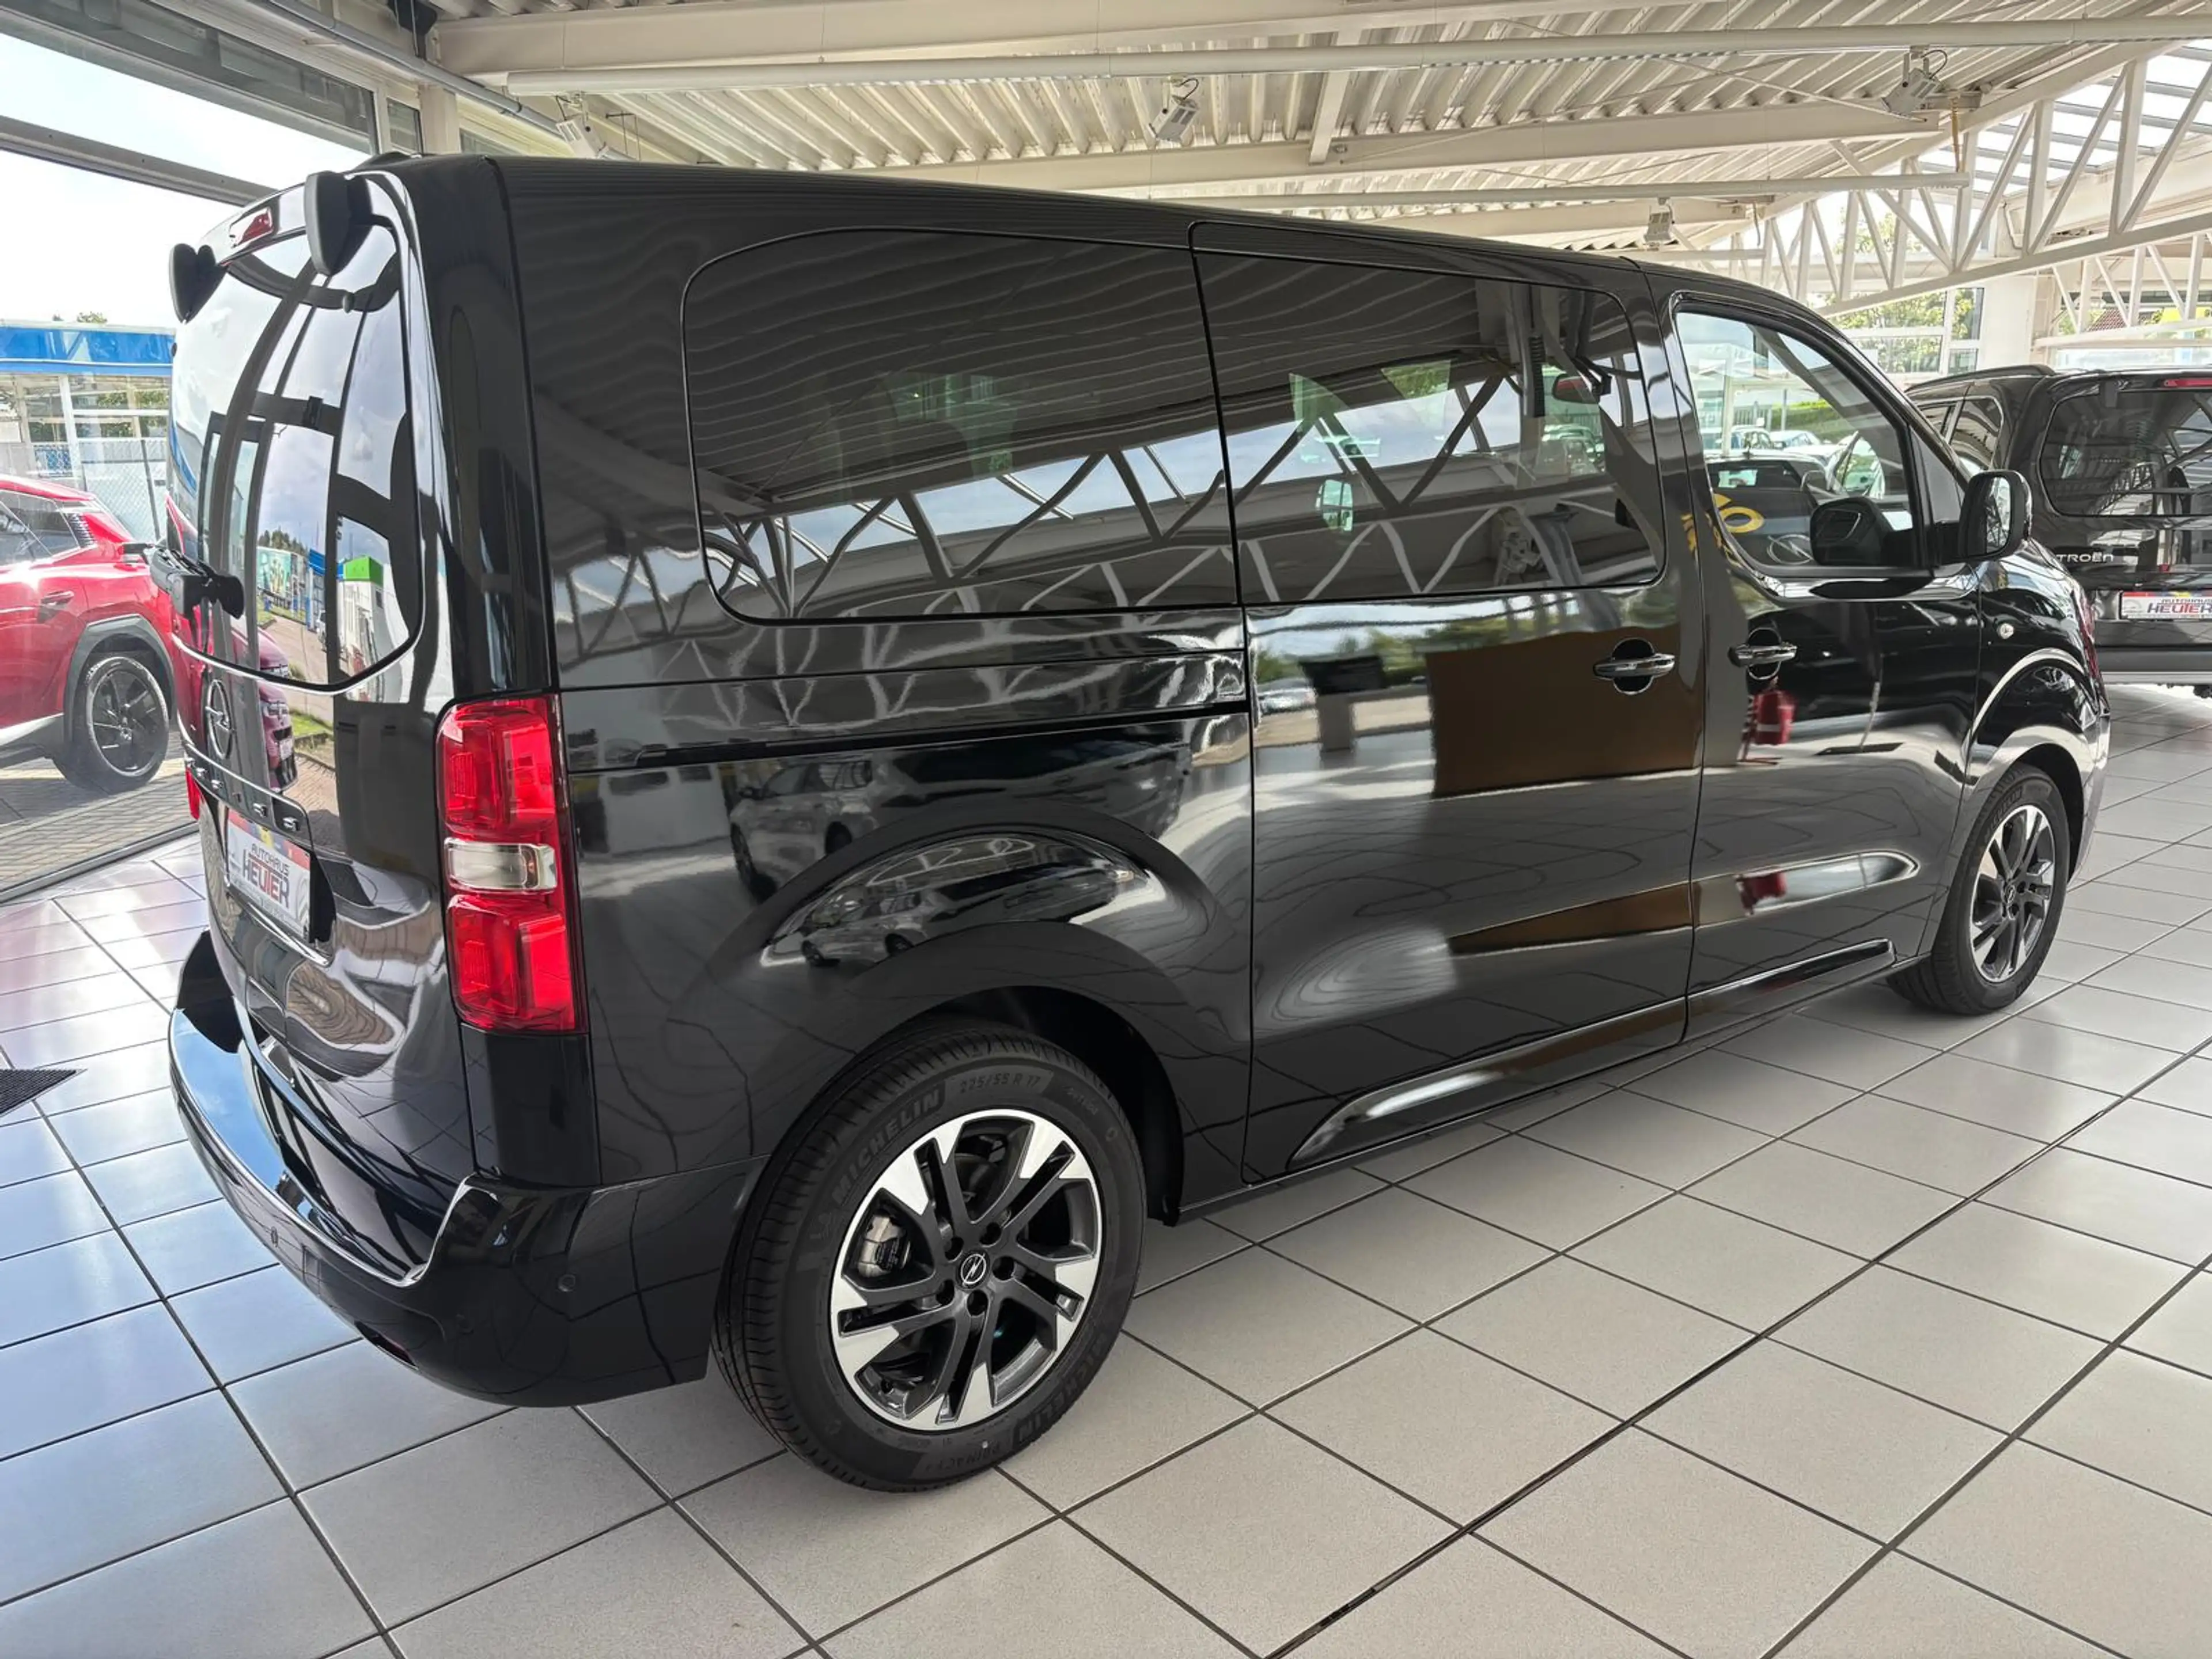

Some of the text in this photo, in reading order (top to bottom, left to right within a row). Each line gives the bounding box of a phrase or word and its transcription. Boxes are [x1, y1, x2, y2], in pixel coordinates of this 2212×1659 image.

[252, 843, 289, 876] AUTOHAUS
[960, 1072, 1041, 1093] 225/55 R 17
[831, 1088, 940, 1205] MICHELIN
